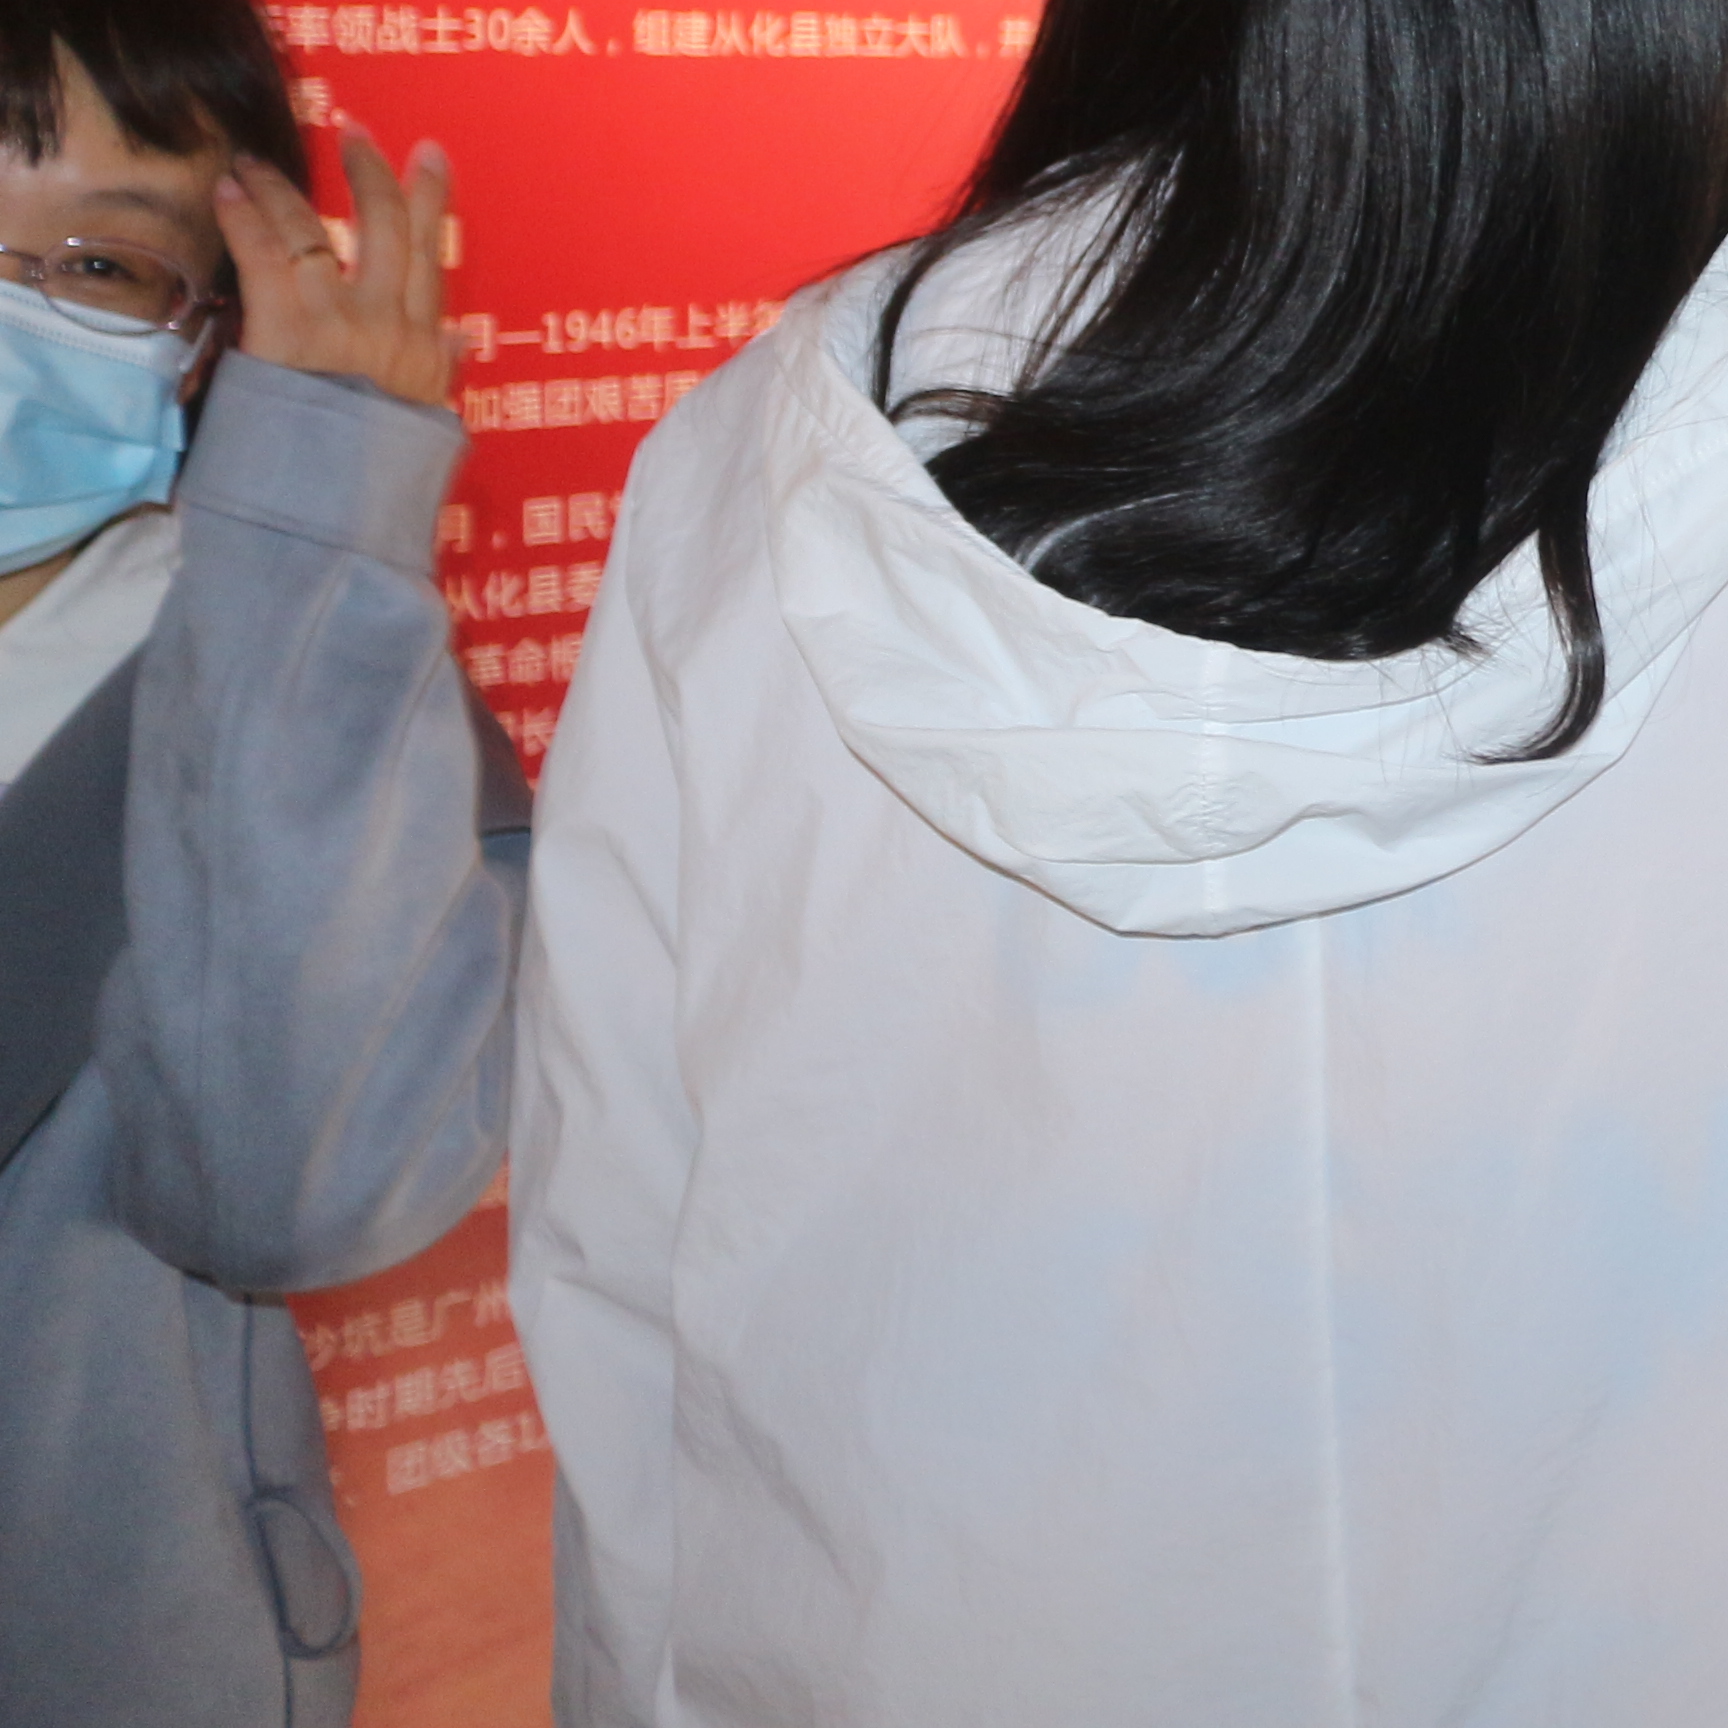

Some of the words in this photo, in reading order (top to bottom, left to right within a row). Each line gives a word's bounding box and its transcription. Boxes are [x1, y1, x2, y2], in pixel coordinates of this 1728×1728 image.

[262, 3, 1038, 59] 率领战士30余人，组建从化县独立大队，并
